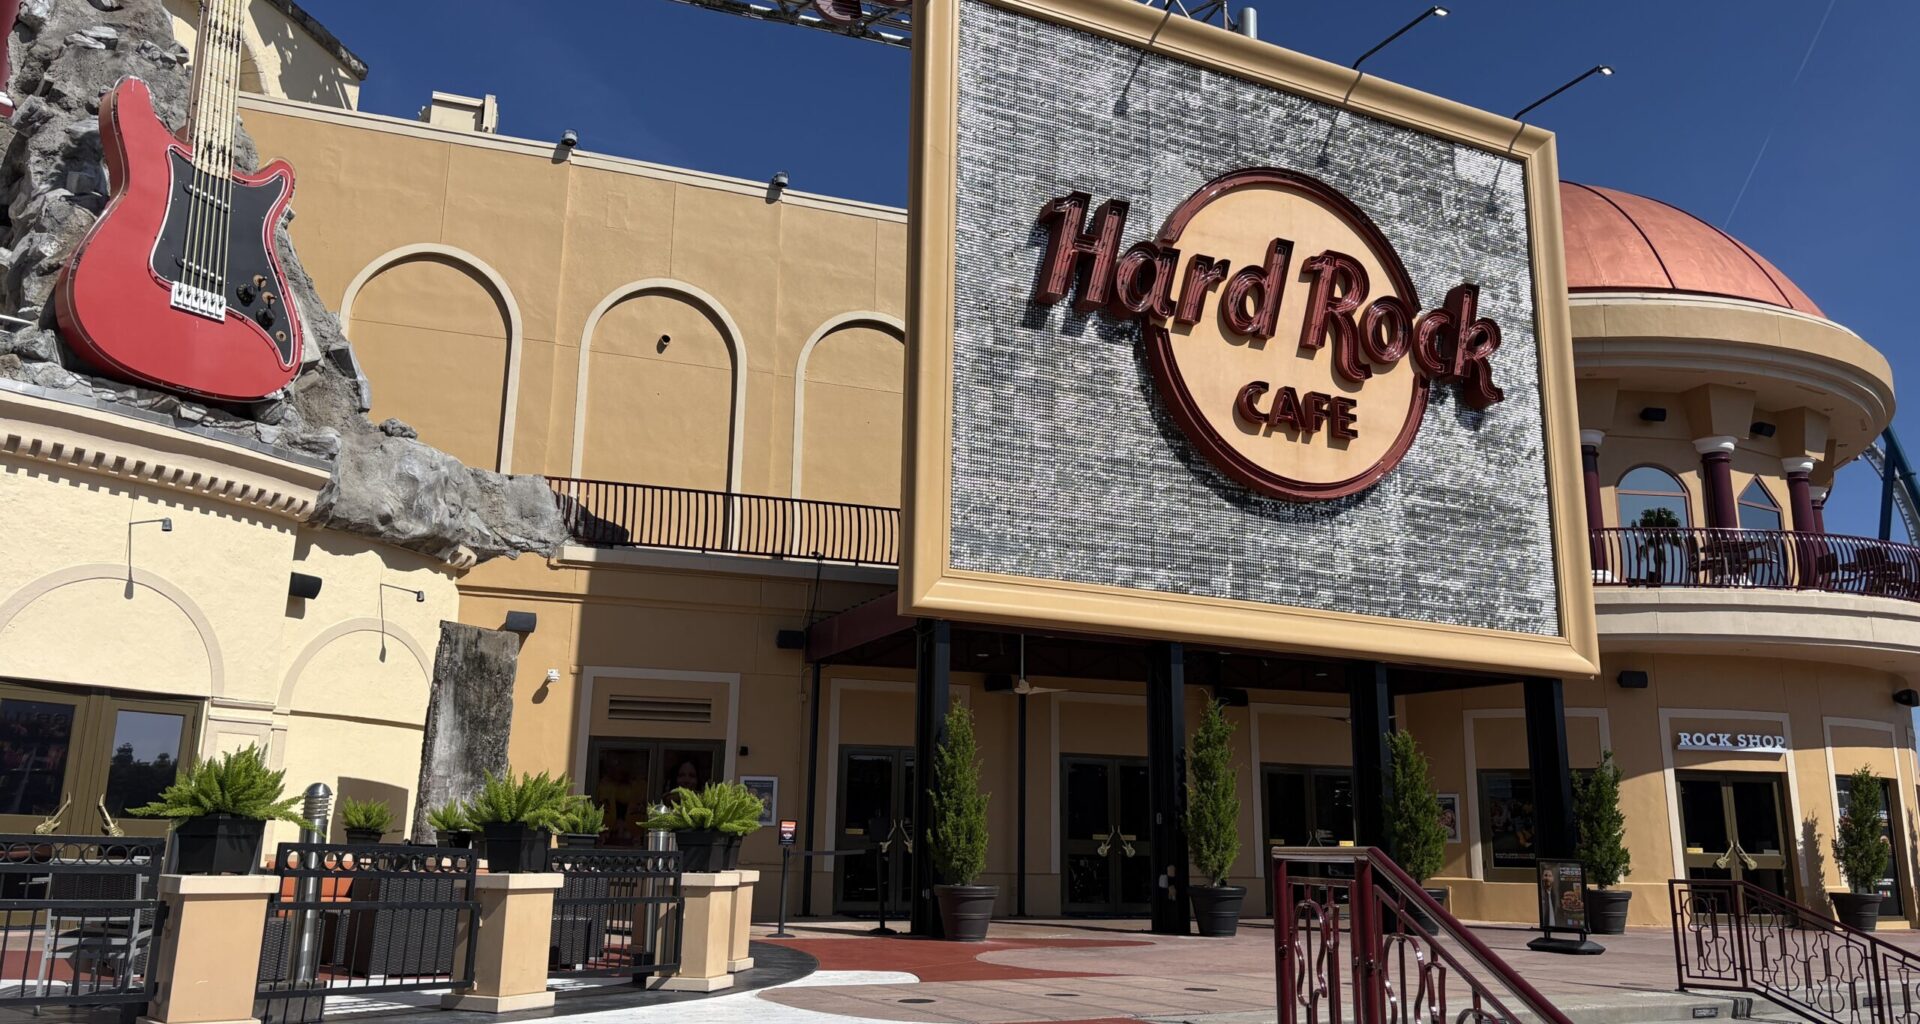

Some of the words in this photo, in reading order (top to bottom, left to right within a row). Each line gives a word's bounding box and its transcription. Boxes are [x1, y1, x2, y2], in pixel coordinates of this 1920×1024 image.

[1036, 191, 1295, 340] Hard
[1298, 249, 1505, 408] Rock
[1236, 381, 1359, 440] CAFE
[1678, 732, 1733, 747] ROCK
[1737, 734, 1785, 749] SHOP
